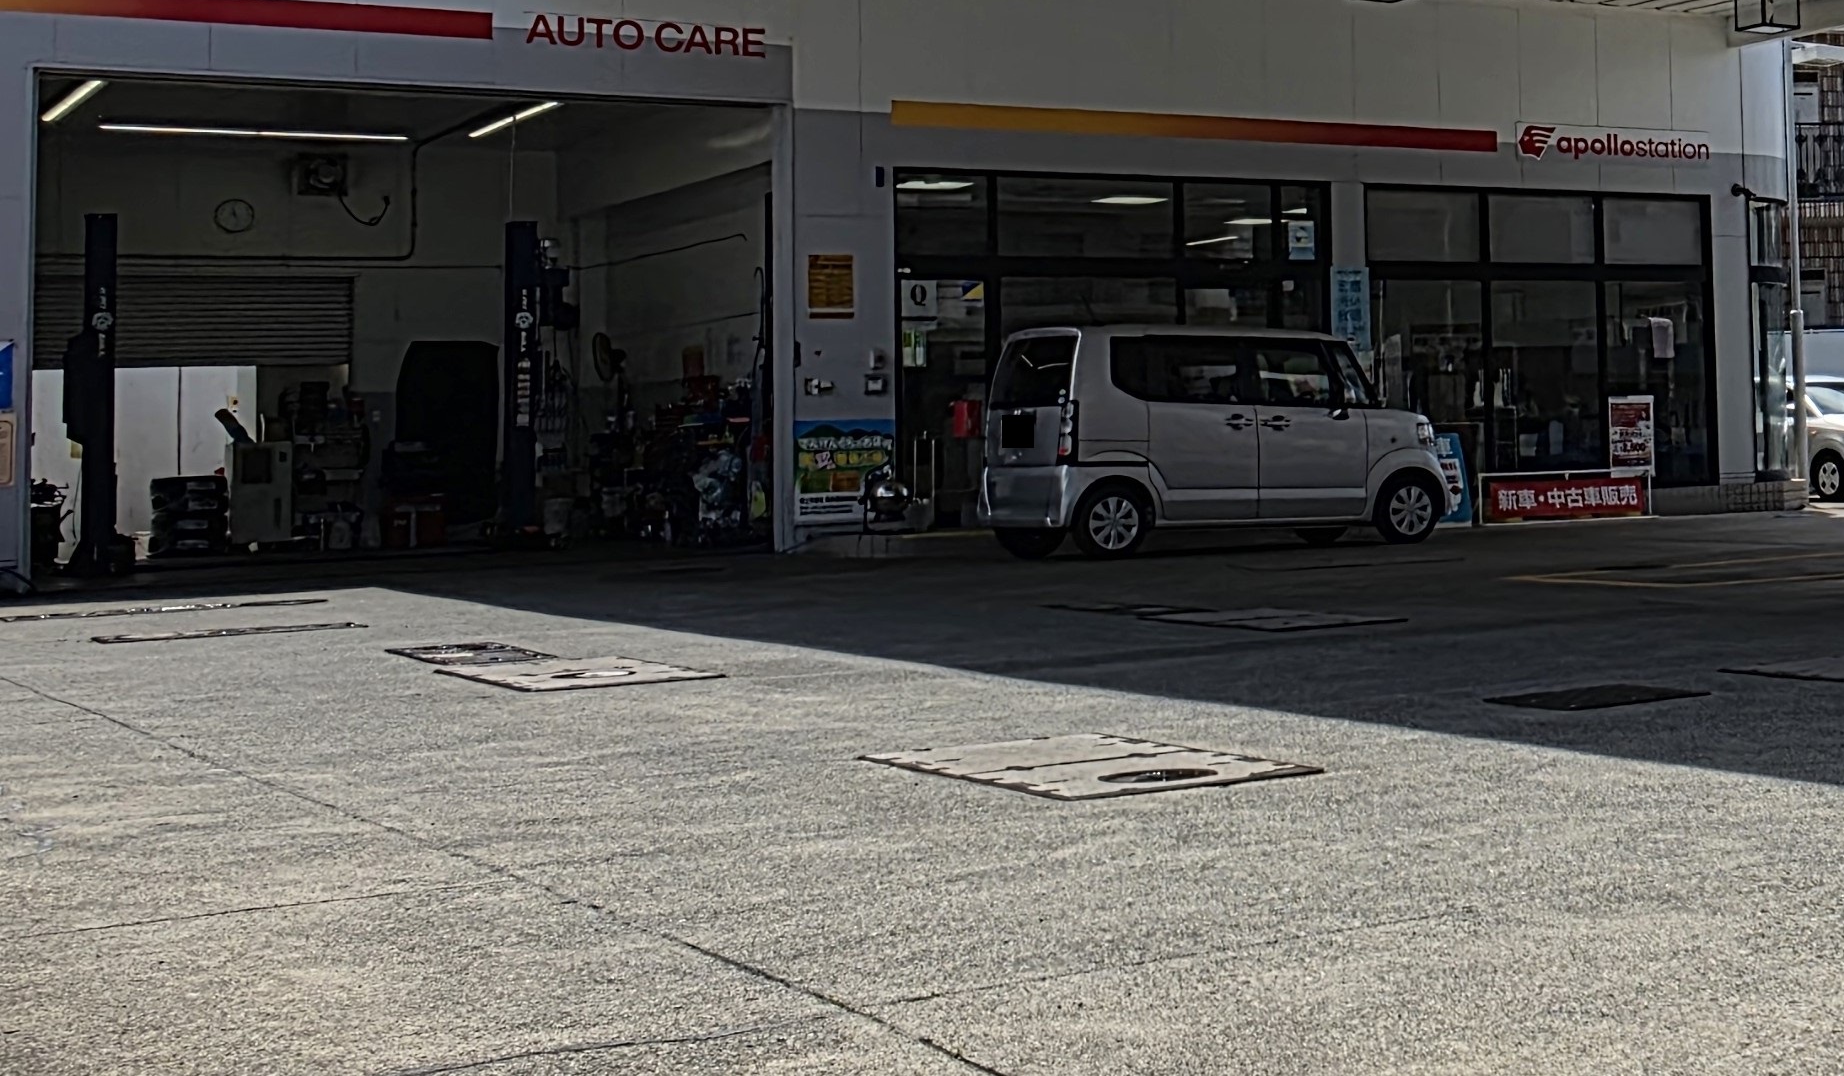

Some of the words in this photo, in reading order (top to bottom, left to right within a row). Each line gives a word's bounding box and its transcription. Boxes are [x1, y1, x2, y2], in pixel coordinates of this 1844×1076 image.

[526, 14, 645, 50] AUTO
[654, 22, 767, 59] CARE
[1556, 132, 1710, 160] apollostation
[910, 283, 928, 307] Q
[1497, 484, 1639, 512] 新車・中古車販売
